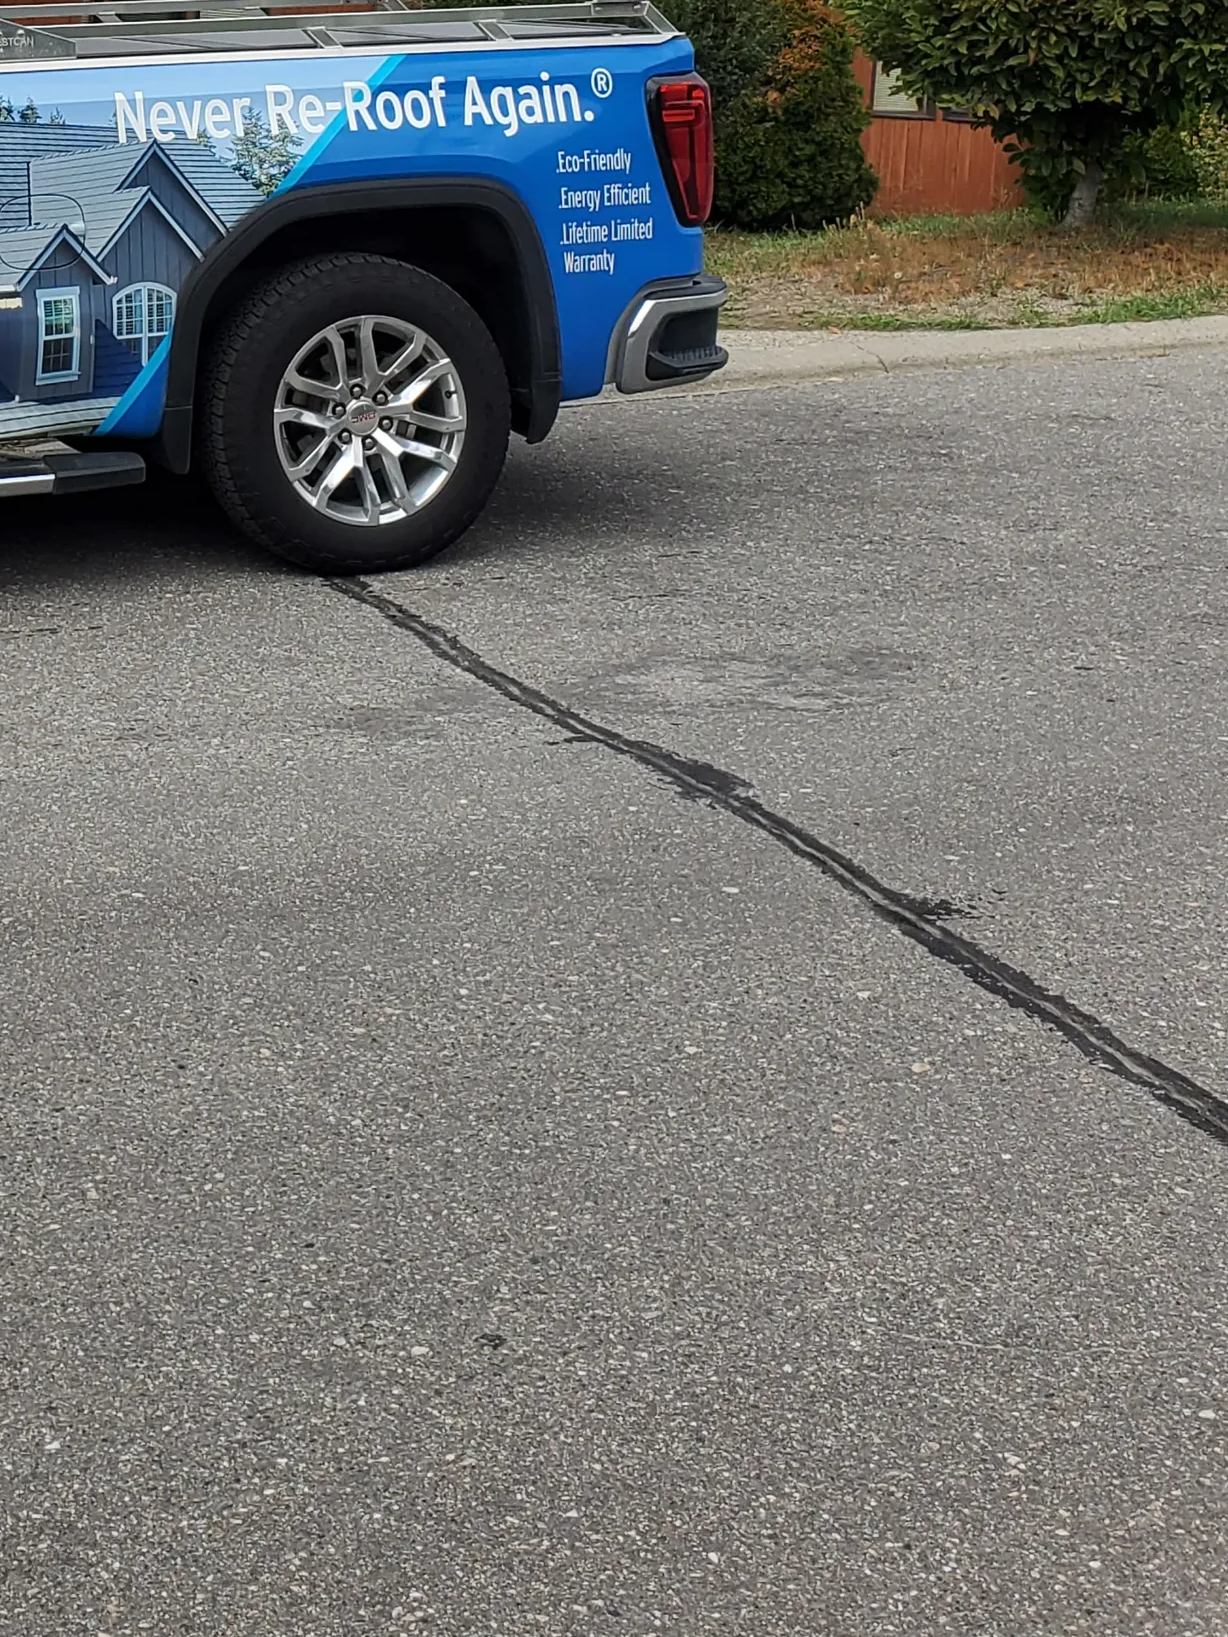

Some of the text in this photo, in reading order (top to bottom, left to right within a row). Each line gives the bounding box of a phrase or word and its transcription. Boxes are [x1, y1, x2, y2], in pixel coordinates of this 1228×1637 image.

[114, 91, 250, 143] Never
[264, 76, 447, 135] Re-Roof
[603, 182, 651, 206] Efficient
[611, 217, 653, 241] Limited
[563, 249, 615, 275] Warranty
